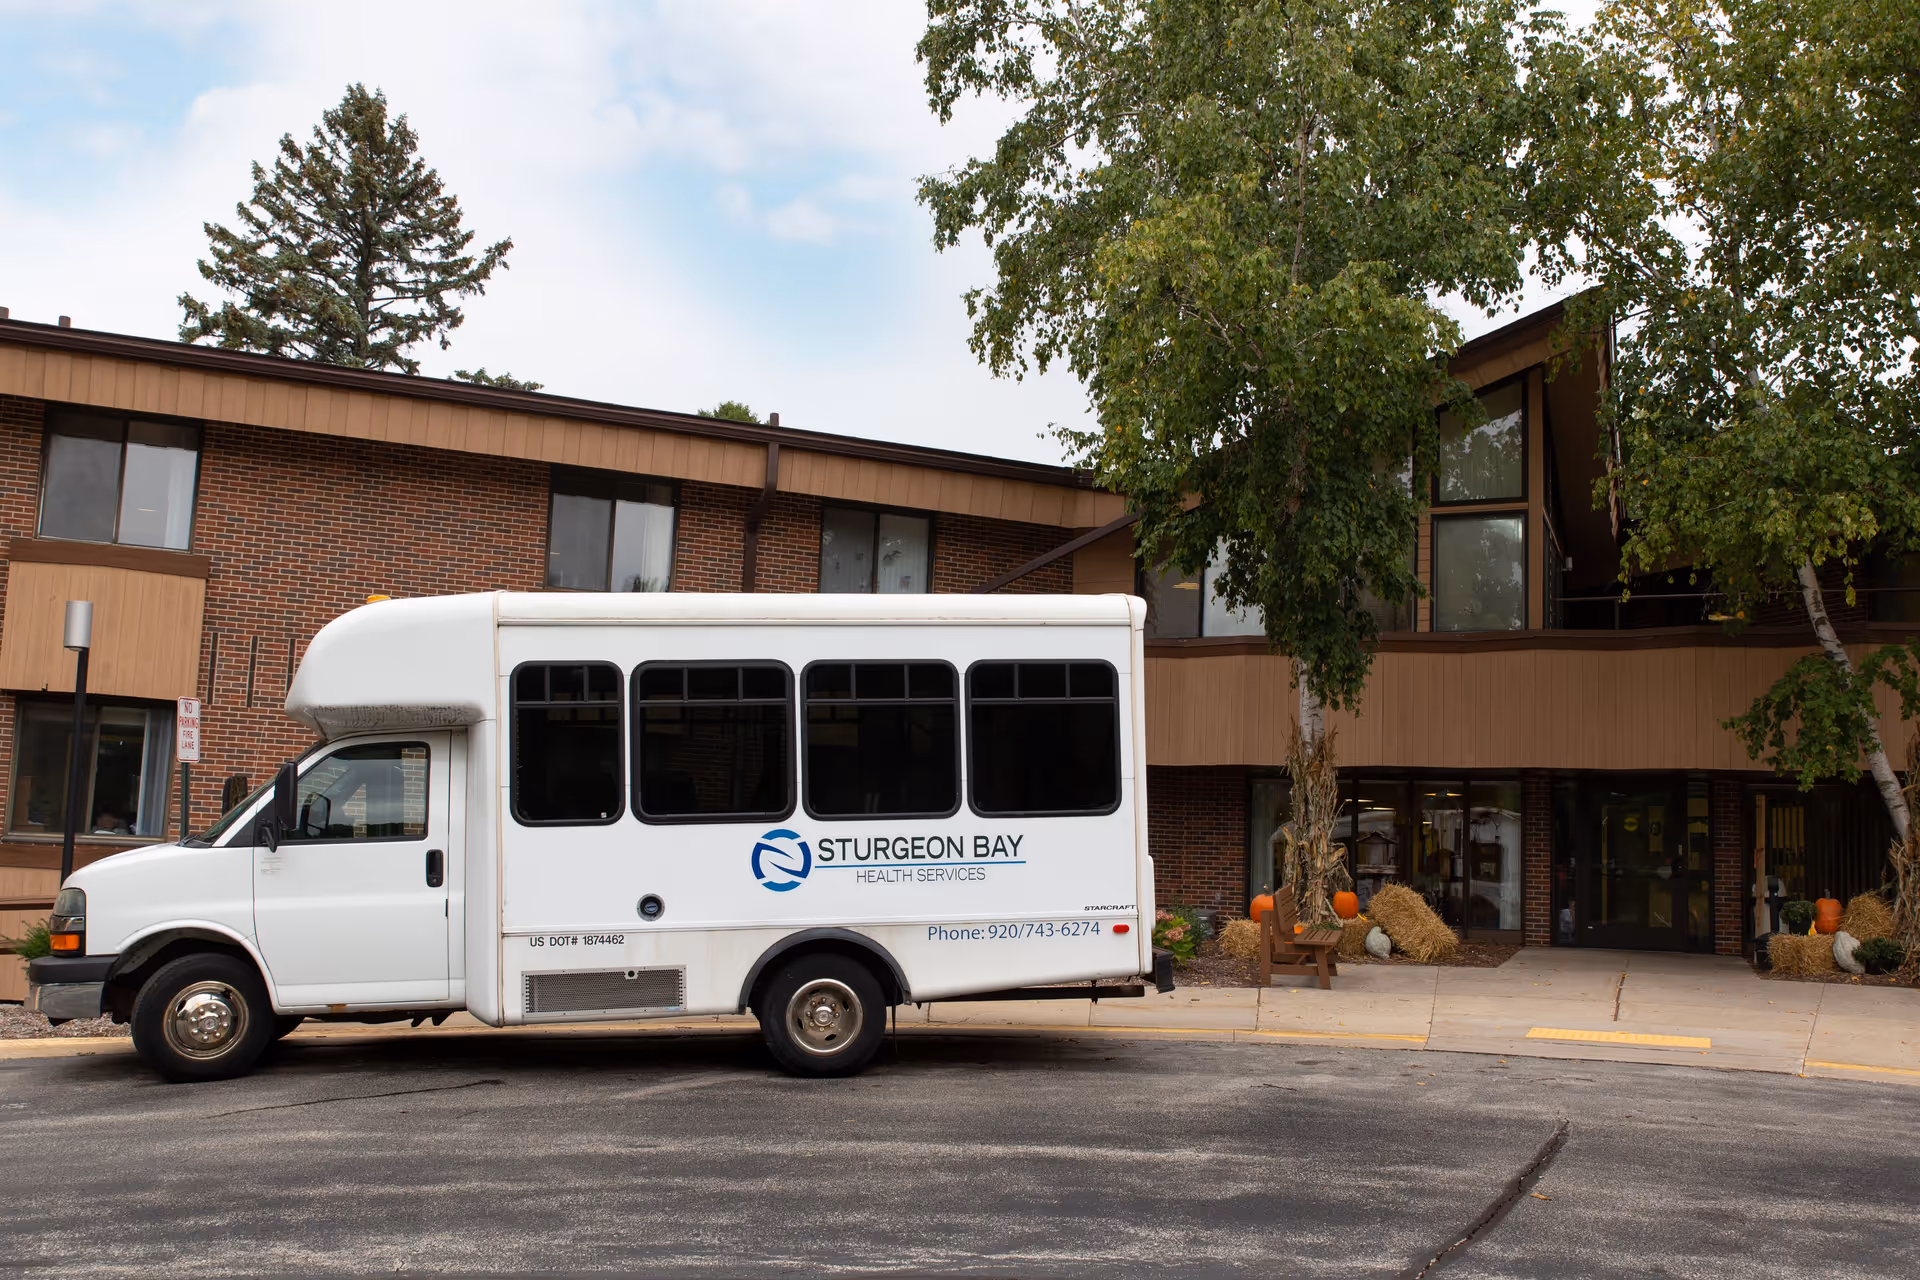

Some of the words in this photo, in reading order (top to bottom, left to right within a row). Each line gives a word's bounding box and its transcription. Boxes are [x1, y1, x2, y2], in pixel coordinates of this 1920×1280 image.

[183, 702, 193, 714] NO
[180, 715, 199, 729] PARKING
[183, 730, 194, 739] FIRE
[181, 741, 195, 750] LANE
[817, 835, 964, 862] STURGEON
[973, 834, 1024, 858] BAY
[856, 868, 913, 884] HEALTH
[916, 867, 986, 882] SERVICES
[927, 925, 985, 941] Phone:
[988, 921, 1101, 939] 920/743-6274
[529, 936, 545, 947] US
[549, 935, 579, 947] DOT#
[582, 934, 625, 946] 1874462
